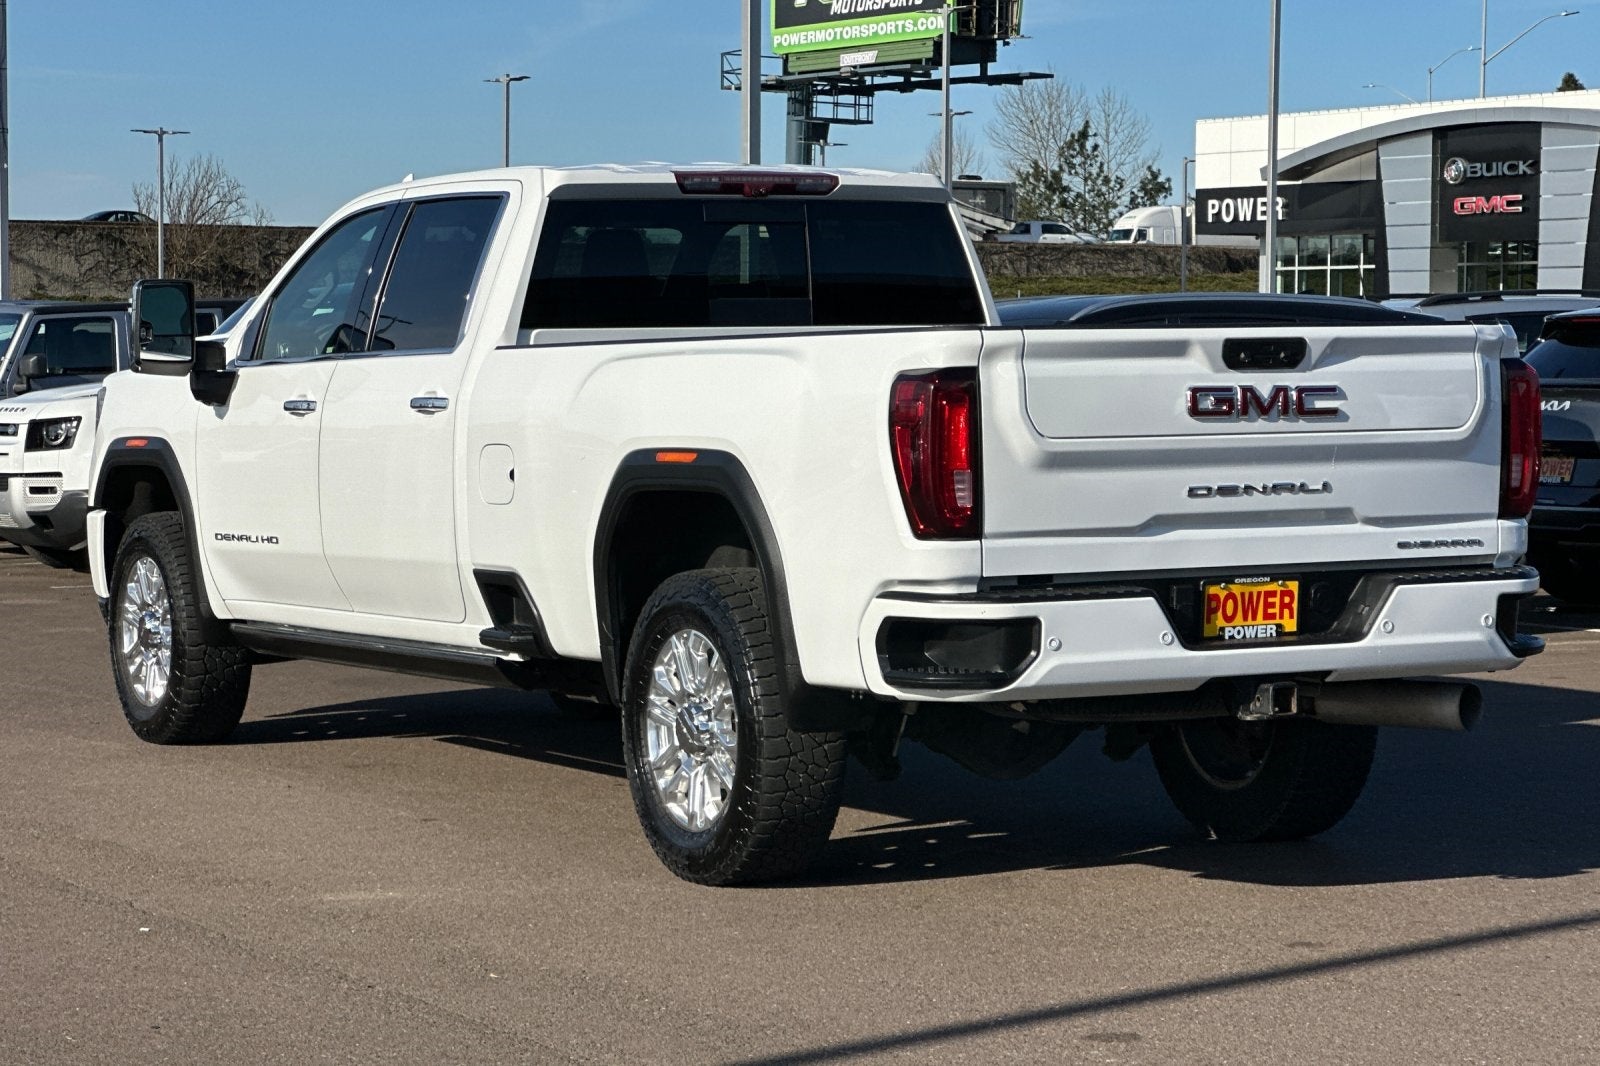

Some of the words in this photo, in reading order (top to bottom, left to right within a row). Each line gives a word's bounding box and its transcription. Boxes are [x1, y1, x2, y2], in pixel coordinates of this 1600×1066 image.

[1466, 160, 1536, 178] BUICK
[1207, 197, 1283, 223] POWER
[1453, 194, 1523, 215] GMC
[1186, 384, 1341, 419] GMC
[1540, 459, 1573, 477] OWER
[1187, 481, 1333, 499] DENALI
[214, 532, 259, 543] DENALI
[261, 535, 279, 544] HD
[1397, 538, 1484, 549] SIERRA
[1234, 576, 1271, 584] OREGON
[1205, 589, 1296, 625] POWER
[1224, 624, 1277, 640] POWER
